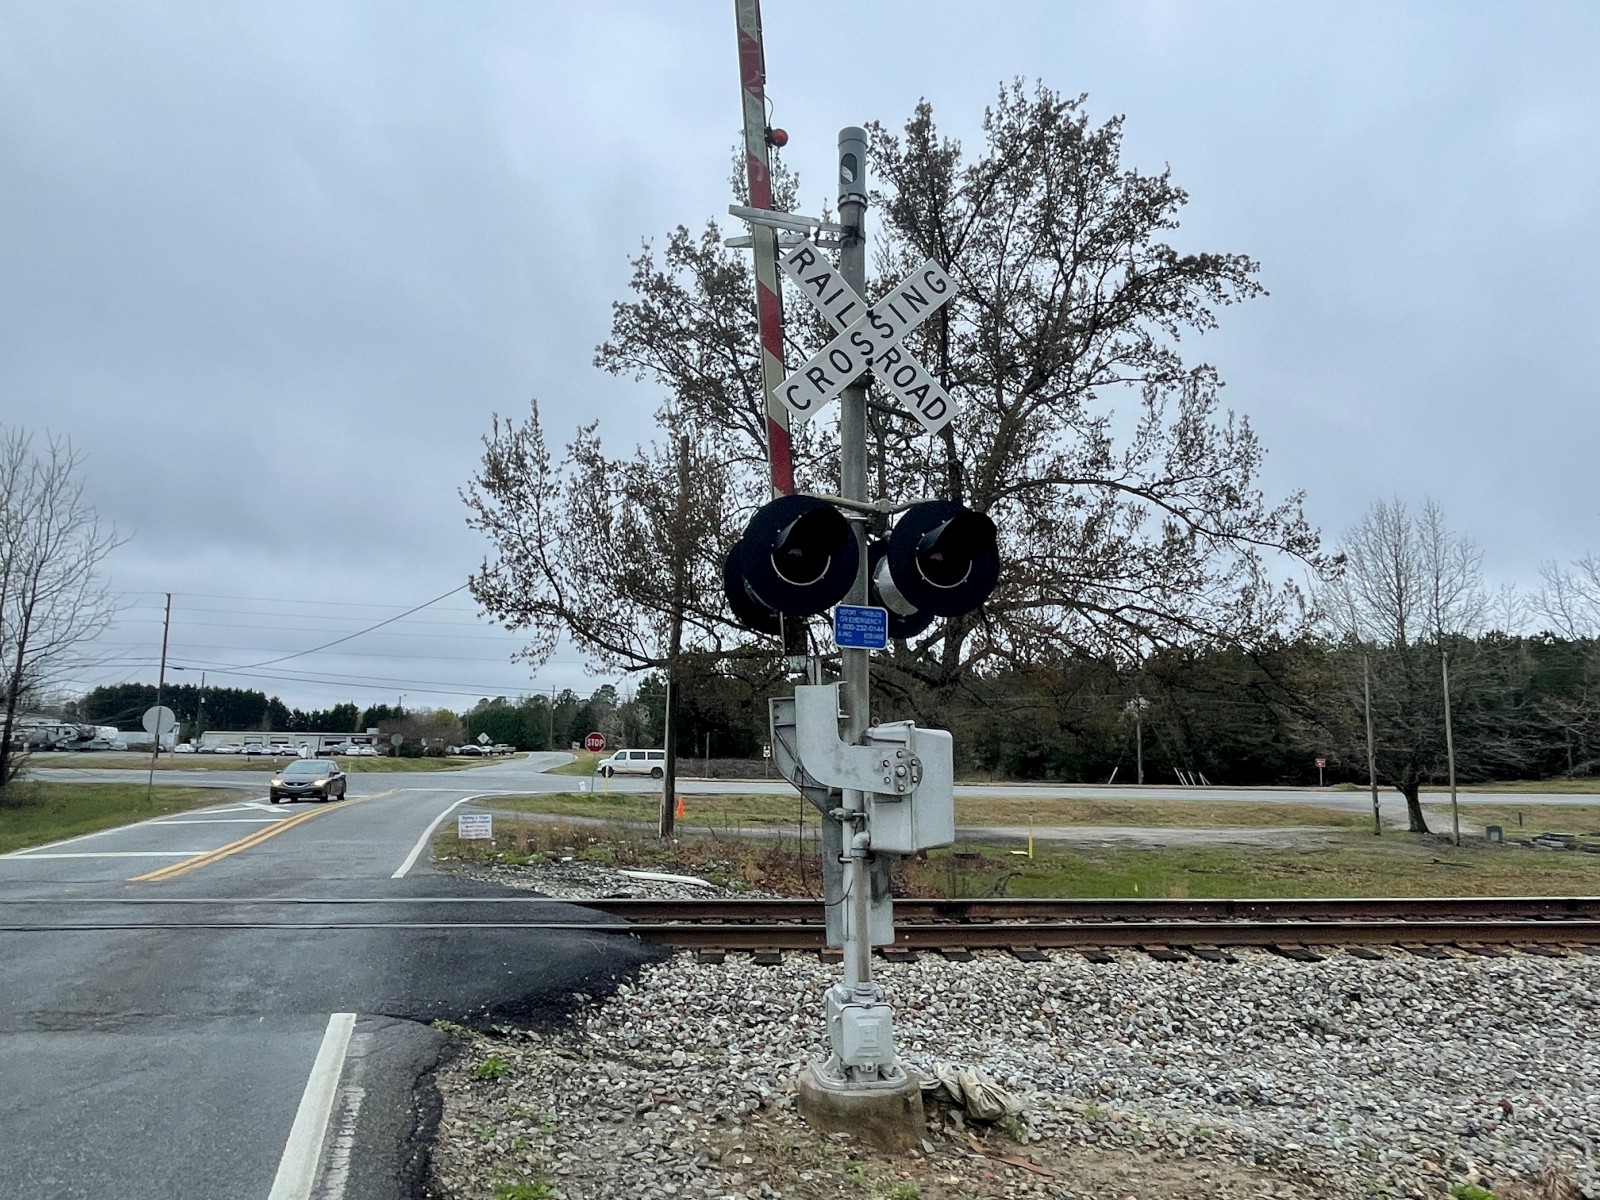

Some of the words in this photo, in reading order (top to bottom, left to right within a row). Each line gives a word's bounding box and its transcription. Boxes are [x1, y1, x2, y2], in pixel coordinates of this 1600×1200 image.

[788, 247, 856, 328] RAIL
[786, 270, 947, 411] CROSSING
[875, 346, 947, 421] ROAD
[587, 738, 604, 747] STOP
